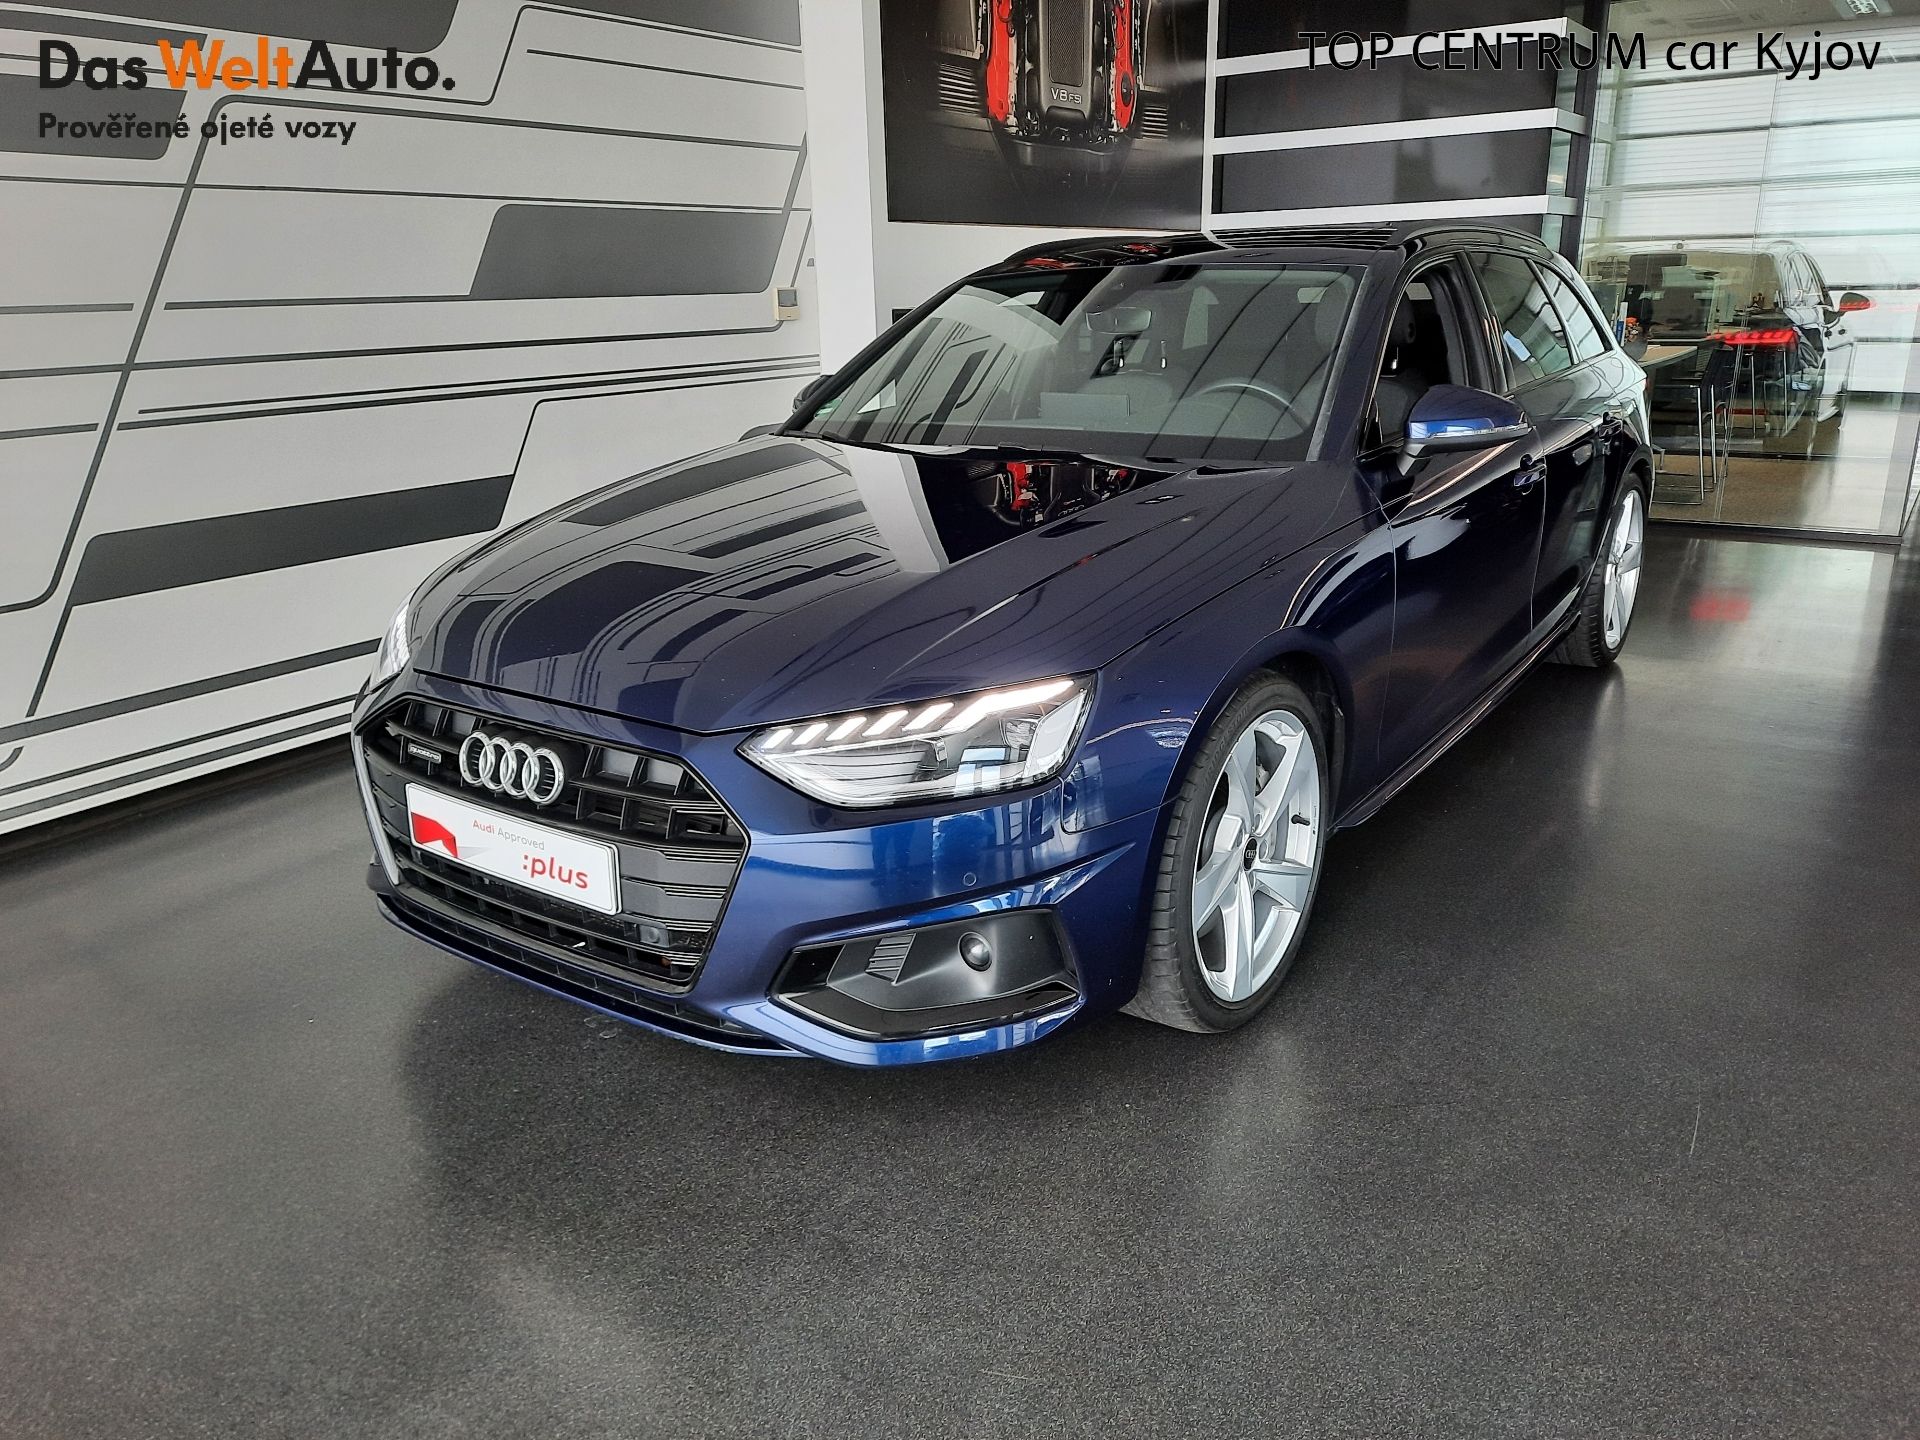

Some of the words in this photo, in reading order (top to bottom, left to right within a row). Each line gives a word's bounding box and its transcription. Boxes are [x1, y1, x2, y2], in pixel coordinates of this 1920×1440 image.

[1051, 87, 1068, 101] V8
[472, 819, 495, 835] Audi
[497, 827, 545, 851] Approved
[522, 853, 589, 889] :plus
